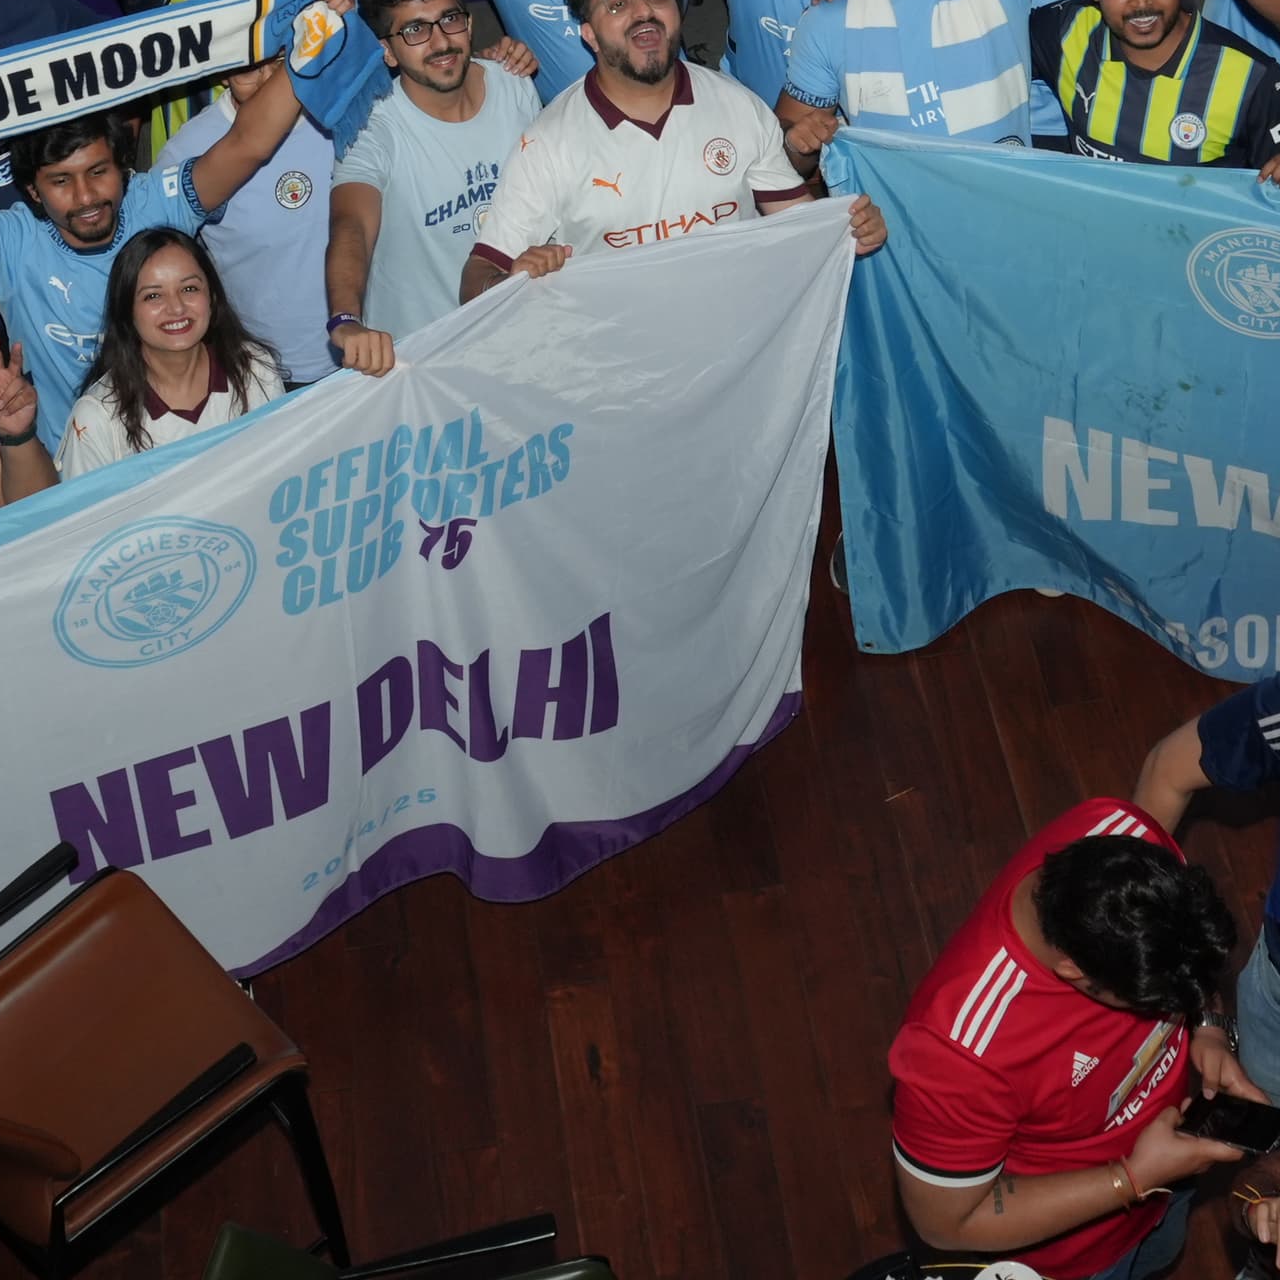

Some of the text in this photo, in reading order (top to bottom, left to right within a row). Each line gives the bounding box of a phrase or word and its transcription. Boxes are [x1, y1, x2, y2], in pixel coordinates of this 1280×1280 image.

[46, 20, 214, 101] MOON
[424, 182, 496, 227] CHAMP
[604, 201, 738, 249] ETIHAD
[1237, 314, 1280, 331] CITY
[269, 407, 489, 524] OFFICIAL
[275, 422, 575, 569] SUPPORTERS
[78, 532, 230, 606] MANCHESTER
[281, 519, 406, 616] CLUB
[418, 517, 480, 570] 75
[138, 626, 194, 657] CITY
[48, 611, 620, 887] NEW DELHI
[302, 789, 437, 892] 204/25
[1072, 1056, 1100, 1088] adidas
[1104, 1045, 1182, 1132] HEVROL
